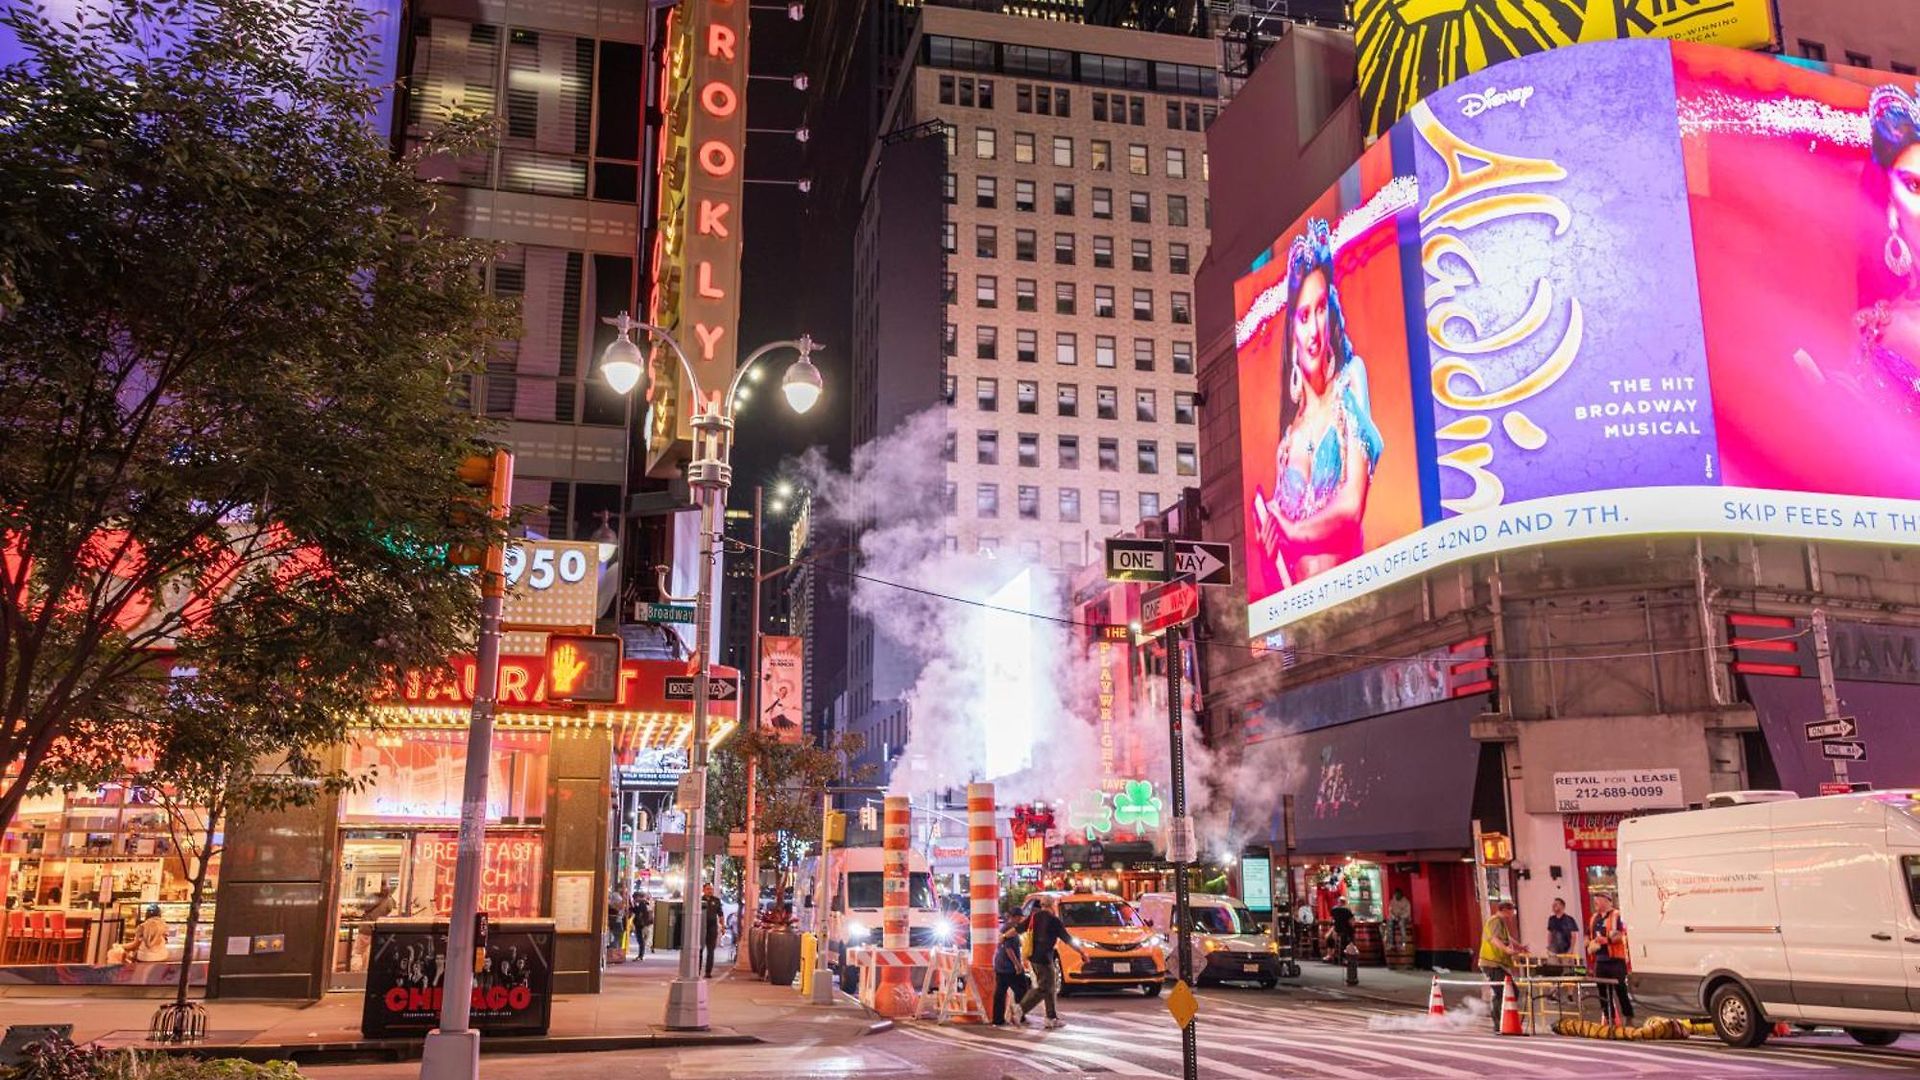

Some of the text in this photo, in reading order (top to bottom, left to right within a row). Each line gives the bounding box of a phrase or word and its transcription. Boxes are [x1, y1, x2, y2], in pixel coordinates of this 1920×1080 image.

[1456, 86, 1534, 118] Disney
[688, 0, 736, 415] ROOKLYN
[1609, 377, 1695, 394] THE HIT
[1574, 399, 1697, 420] BROADWAY
[1604, 421, 1701, 438] MUSICAL
[1724, 502, 1920, 532] SKIP FEES AT TH
[1119, 552, 1154, 569] ONE
[1291, 590, 1314, 610] FEES
[1318, 584, 1329, 602] AT
[1333, 574, 1353, 590] THE
[1357, 566, 1380, 585] BOX
[1384, 542, 1429, 574] OFFICE
[1438, 524, 1487, 549] 42ND
[1497, 513, 1553, 538] AND
[1565, 504, 1629, 527] 7TH.
[504, 548, 586, 589] 950
[647, 606, 694, 621] Broadway
[1144, 589, 1189, 620] ONE WAY
[1105, 627, 1127, 639] THE
[671, 683, 694, 694] ONE
[1099, 641, 1114, 774] PLAYWRIGHT
[1811, 723, 1848, 736] ONE WAY
[1102, 779, 1126, 790] TAVE
[1555, 777, 1600, 785] RETAIL
[1633, 773, 1678, 783] LEASE
[1576, 786, 1664, 798] 212-689-0099
[423, 842, 534, 861] BREFAST
[444, 867, 510, 887] LCH
[441, 894, 509, 912] DNER
[384, 986, 531, 1012] CHIAGO
